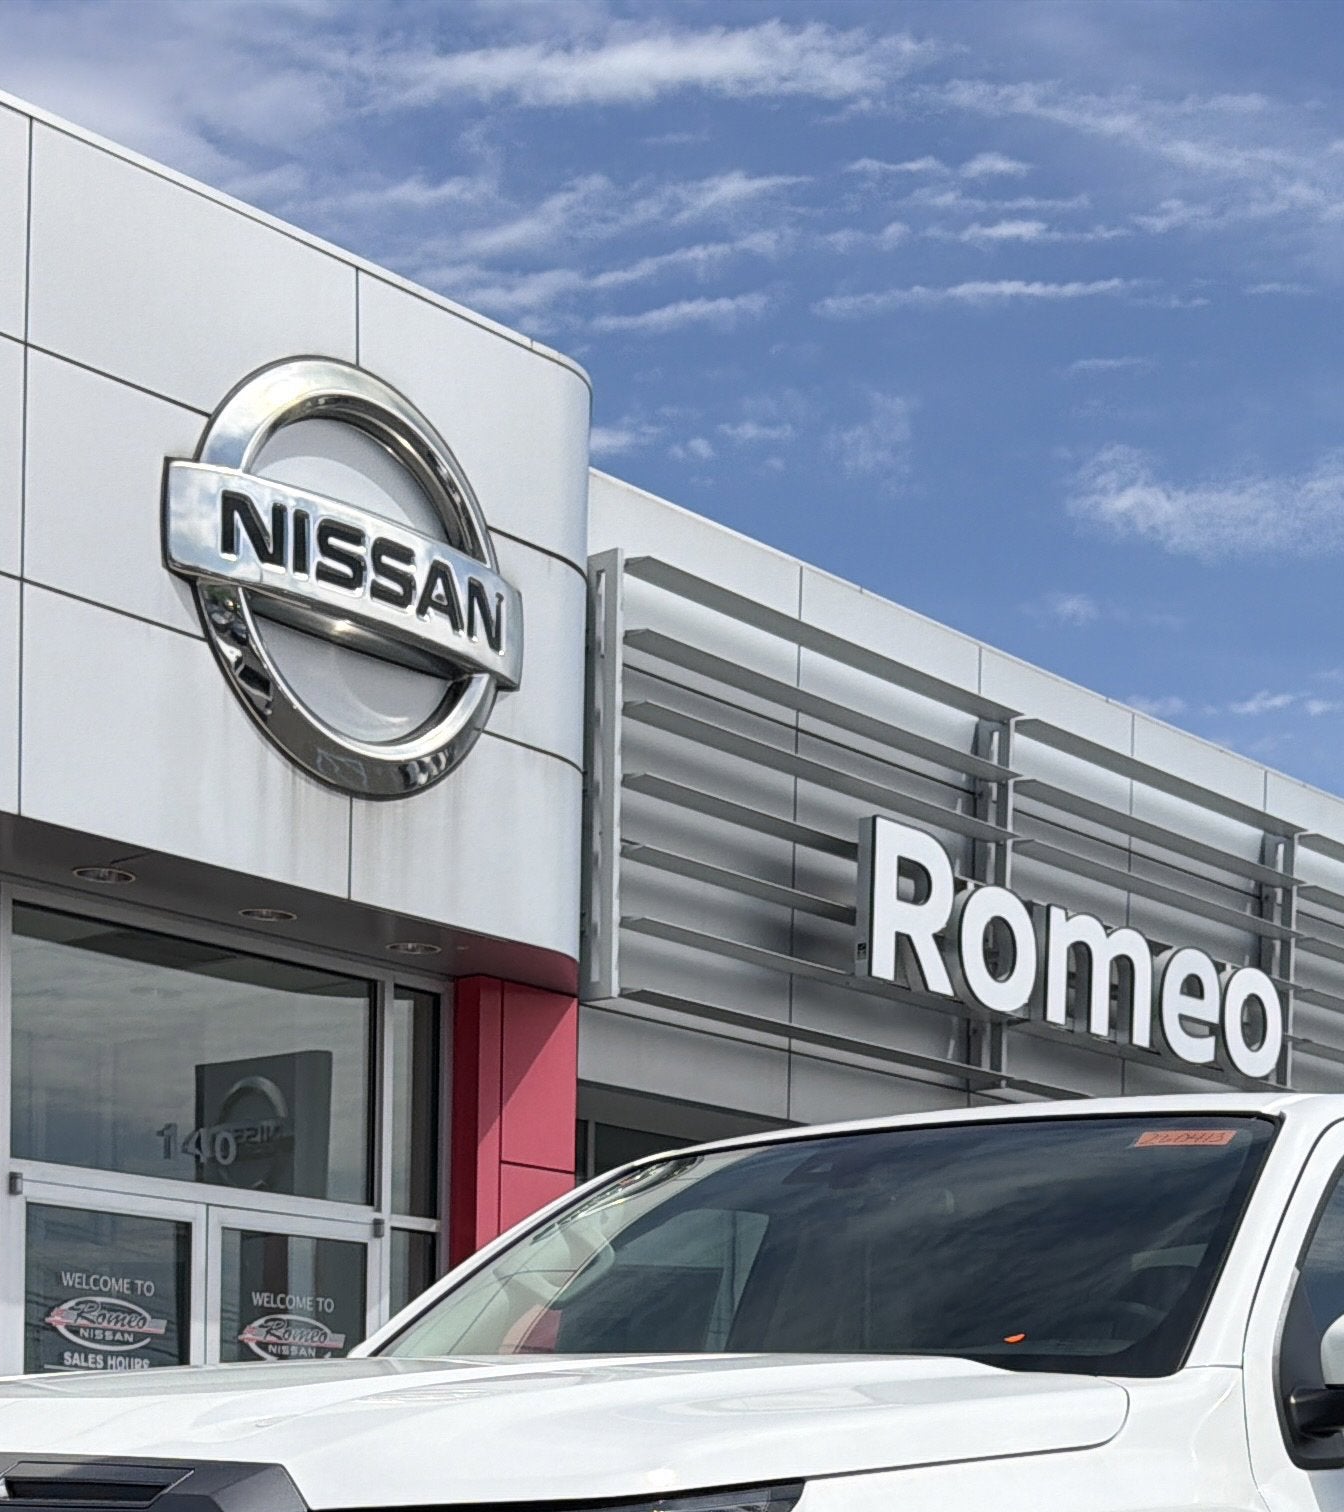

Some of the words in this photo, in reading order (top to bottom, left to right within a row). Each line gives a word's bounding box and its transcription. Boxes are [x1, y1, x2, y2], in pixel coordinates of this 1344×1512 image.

[220, 489, 506, 656] NISSAN
[867, 814, 1284, 1078] Romeo
[156, 1122, 237, 1166] 140
[61, 1271, 131, 1294] WELCOME
[134, 1280, 155, 1297] TO
[71, 1300, 148, 1329] Romeo
[251, 1291, 314, 1312] WELCOME
[316, 1297, 335, 1313] TO
[79, 1328, 134, 1343] NISSAN
[259, 1318, 328, 1344] Romeo
[63, 1351, 104, 1369] SALES
[107, 1355, 151, 1371] HOURS
[268, 1344, 316, 1358] NISSAN
